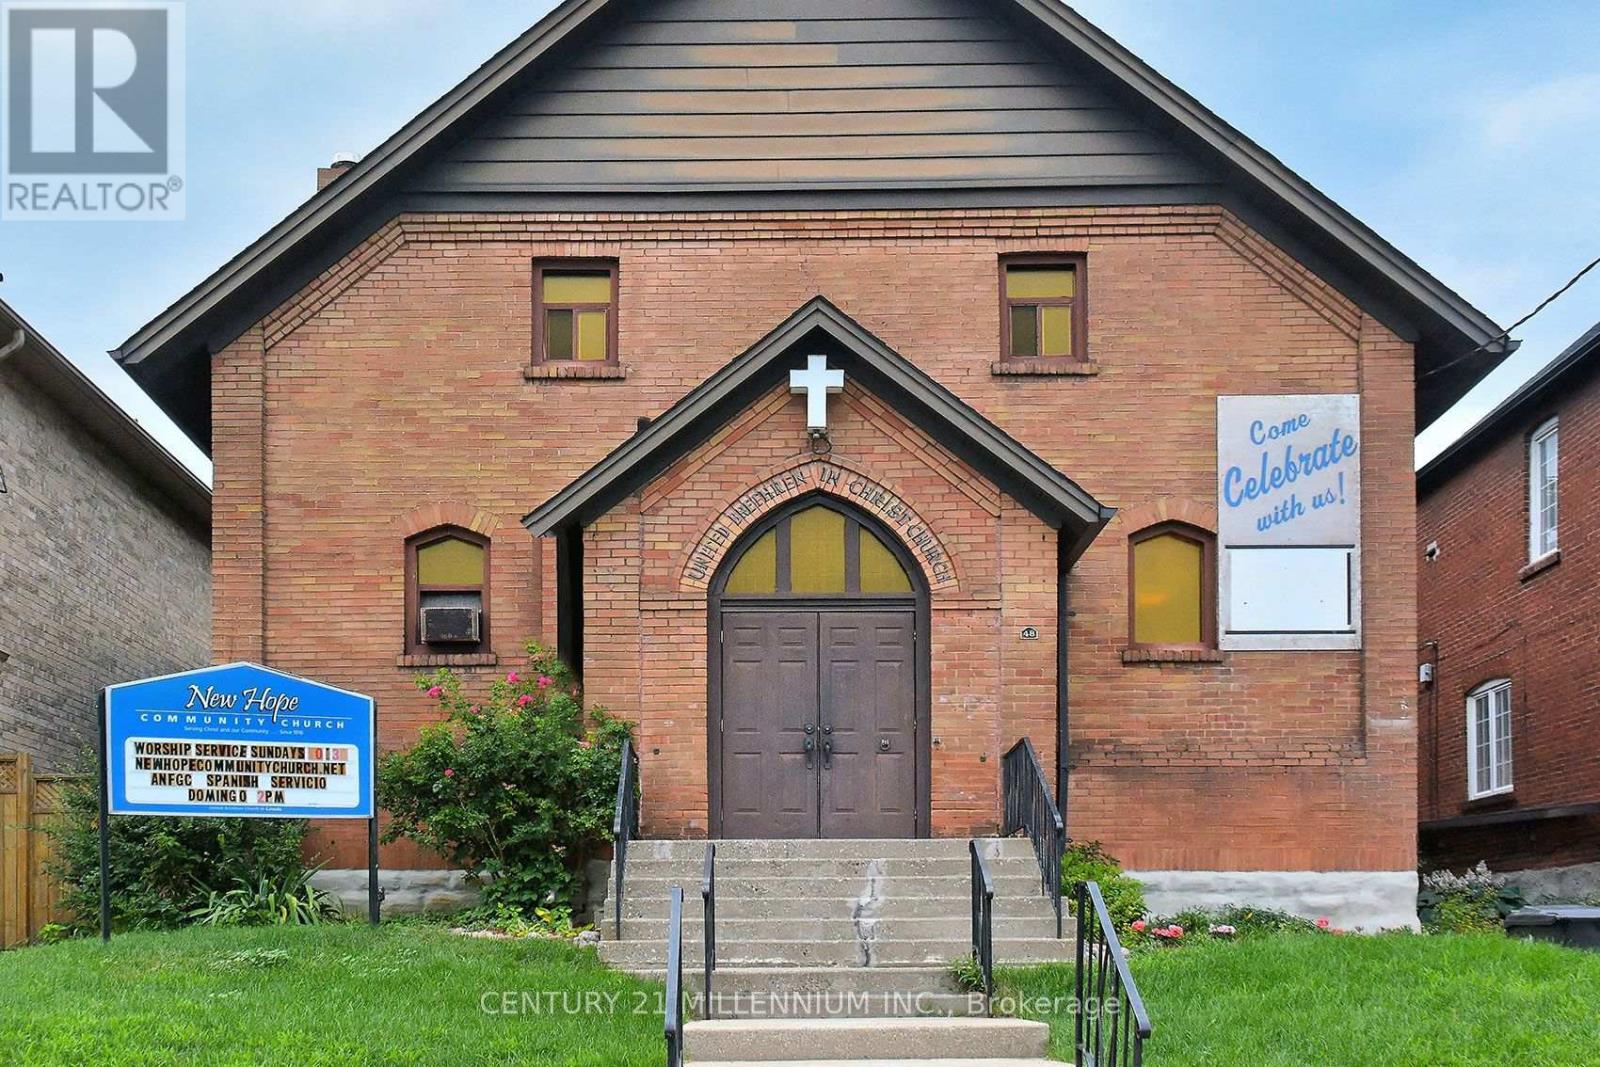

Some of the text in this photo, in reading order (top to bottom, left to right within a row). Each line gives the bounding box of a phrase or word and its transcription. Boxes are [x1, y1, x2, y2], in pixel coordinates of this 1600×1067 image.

[1250, 413, 1311, 446] Come
[1223, 428, 1358, 508] Celebrate
[1257, 471, 1346, 532] with us!
[688, 525, 730, 580] UNITED
[821, 467, 840, 488] IN
[848, 478, 912, 527] CHRIST
[906, 521, 952, 585] CHURCH
[140, 712, 345, 729] COMMUNITY CHURCH
[186, 684, 300, 724] New Hope
[134, 741, 192, 756] WORSHIP
[195, 743, 248, 758] SERVICE
[250, 745, 306, 760] SUNDAYS
[151, 772, 327, 790] ANFGC SPANISH SERVICIO
[188, 788, 247, 803] DOMINGO
